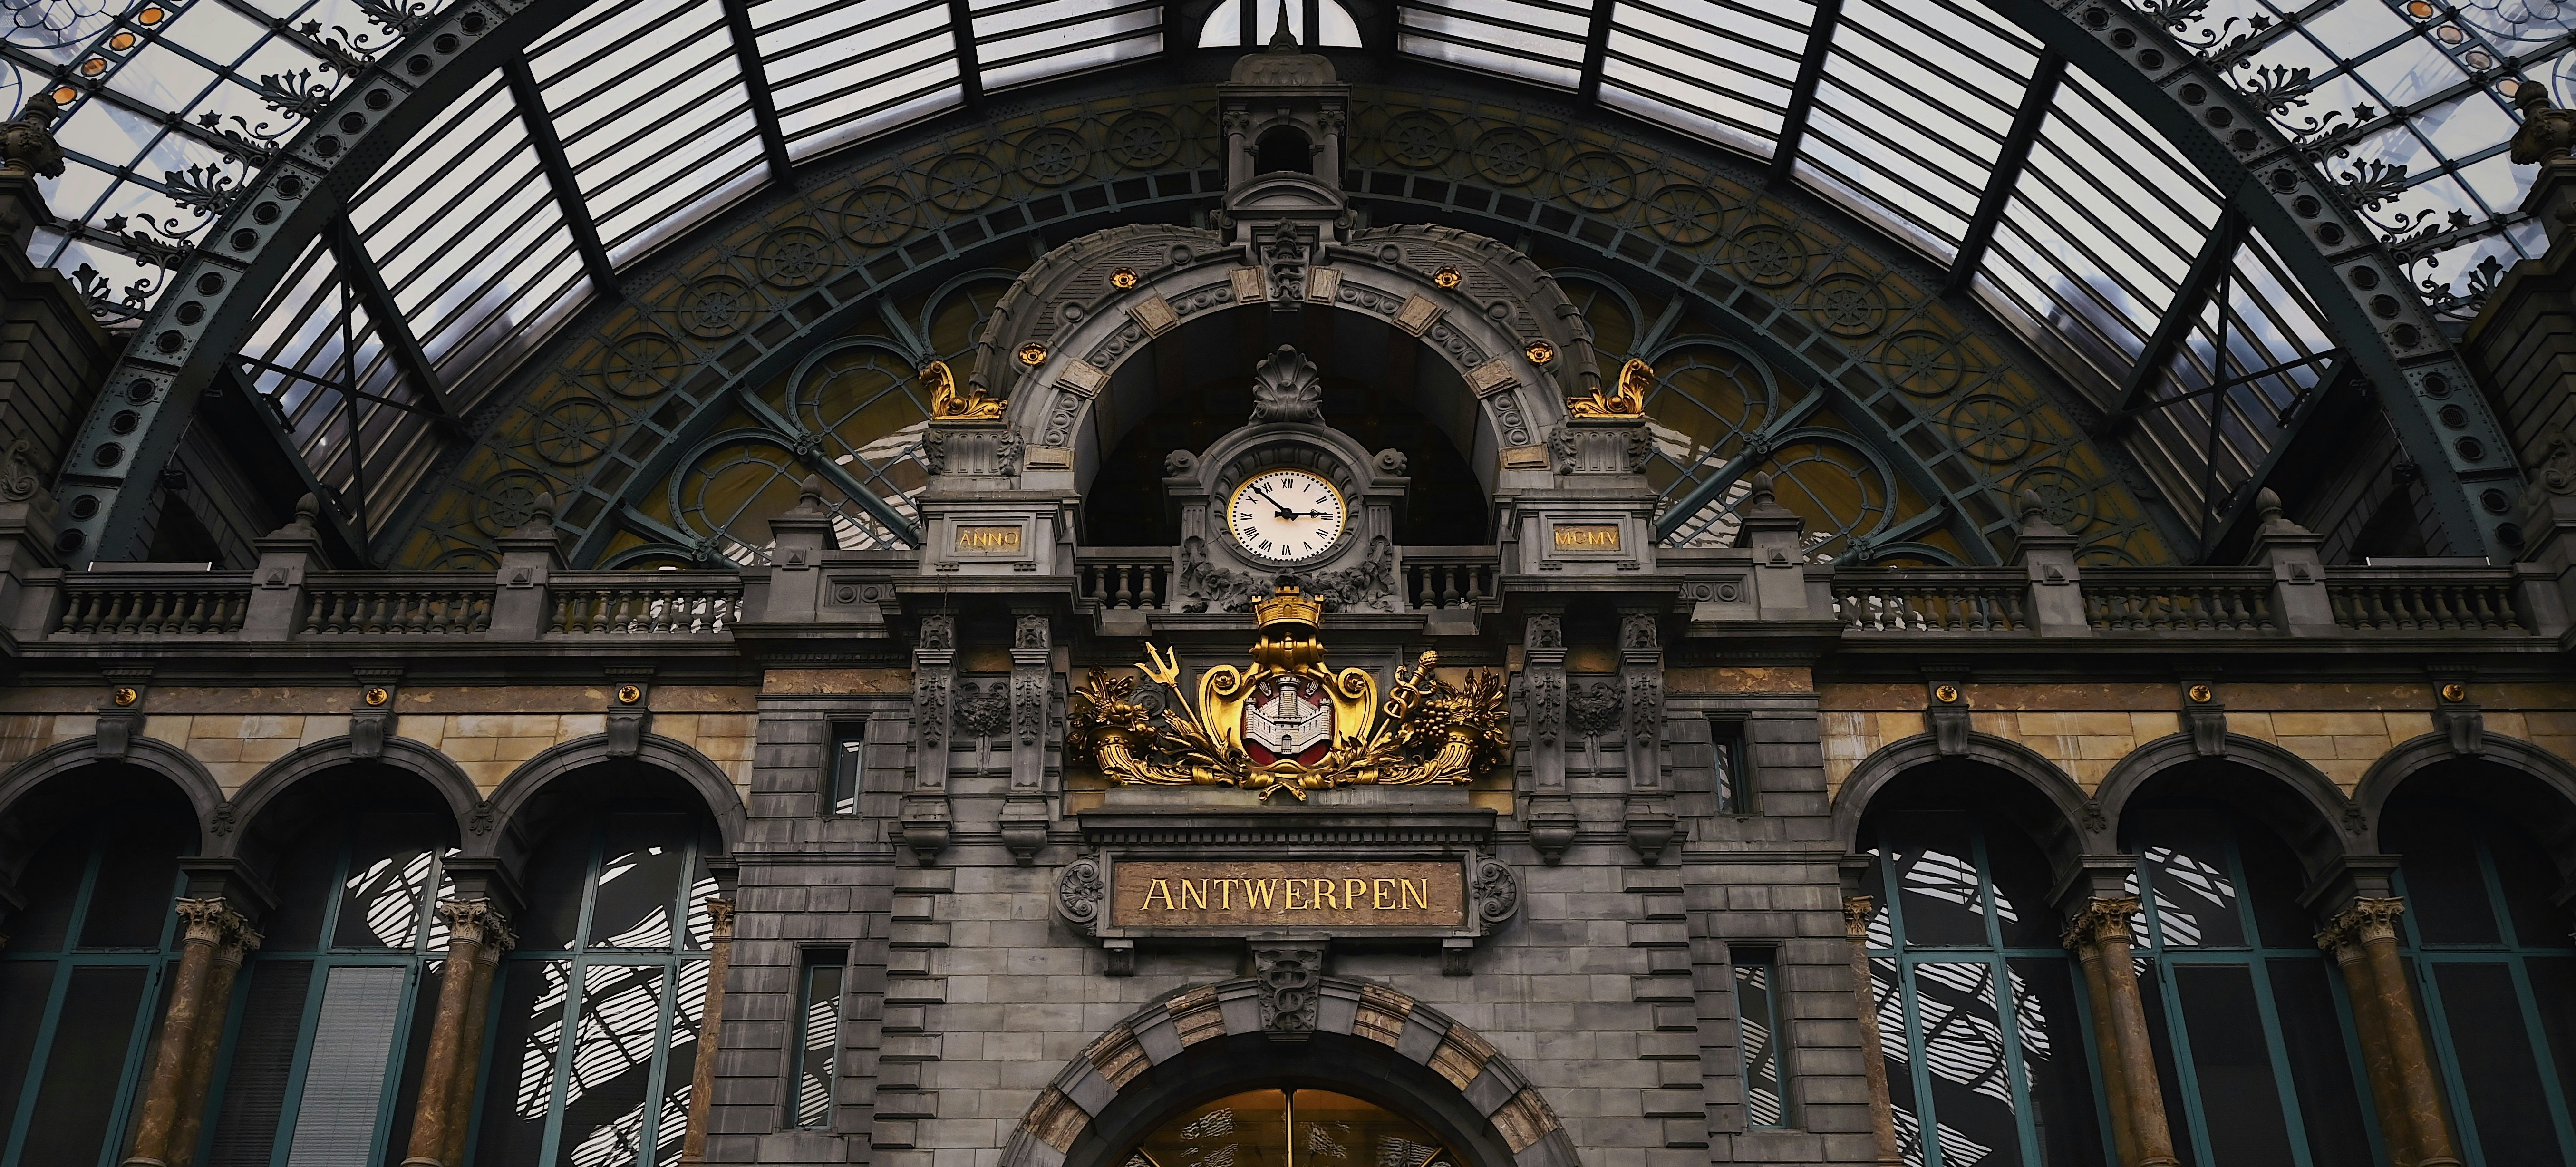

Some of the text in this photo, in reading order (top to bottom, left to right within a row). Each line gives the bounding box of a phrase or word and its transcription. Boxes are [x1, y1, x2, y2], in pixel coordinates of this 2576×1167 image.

[1260, 482, 1273, 493] XI
[1281, 478, 1294, 489] XII
[1303, 484, 1310, 492] I
[1246, 496, 1259, 504] X
[1240, 512, 1253, 520] IX
[1243, 526, 1259, 541] VIII
[1316, 529, 1329, 539] IV
[959, 532, 1019, 546] ANNO
[1259, 539, 1272, 553] VII
[1282, 545, 1291, 555] VI
[1304, 542, 1312, 551] V
[1140, 877, 1430, 911] ANTWERPEN
